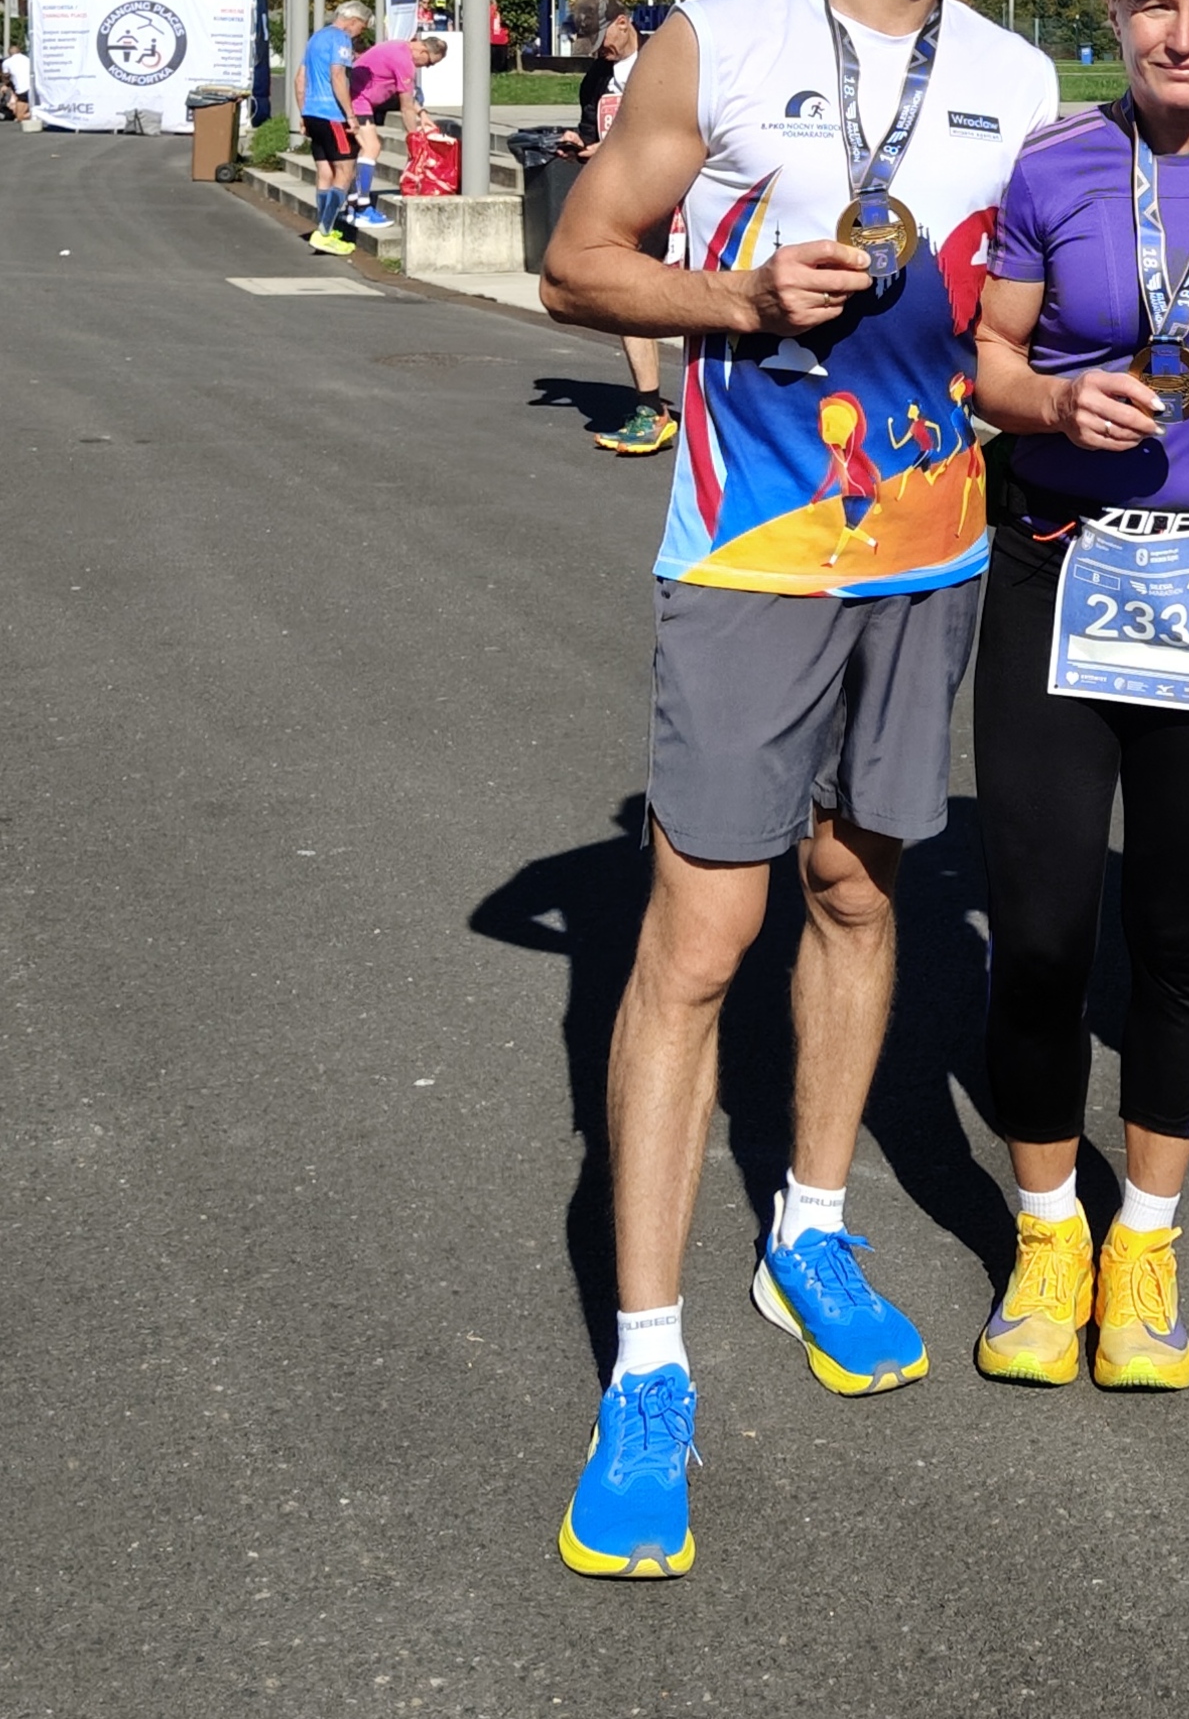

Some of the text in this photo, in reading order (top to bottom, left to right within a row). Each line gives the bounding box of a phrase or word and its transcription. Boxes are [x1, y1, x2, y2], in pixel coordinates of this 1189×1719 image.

[100, 0, 185, 37] CHANGING PLACES
[108, 63, 174, 86] KOMFORTKA
[843, 74, 855, 99] 18.
[880, 144, 902, 164] 18.
[1142, 248, 1158, 272] 18.
[1092, 573, 1100, 583] B
